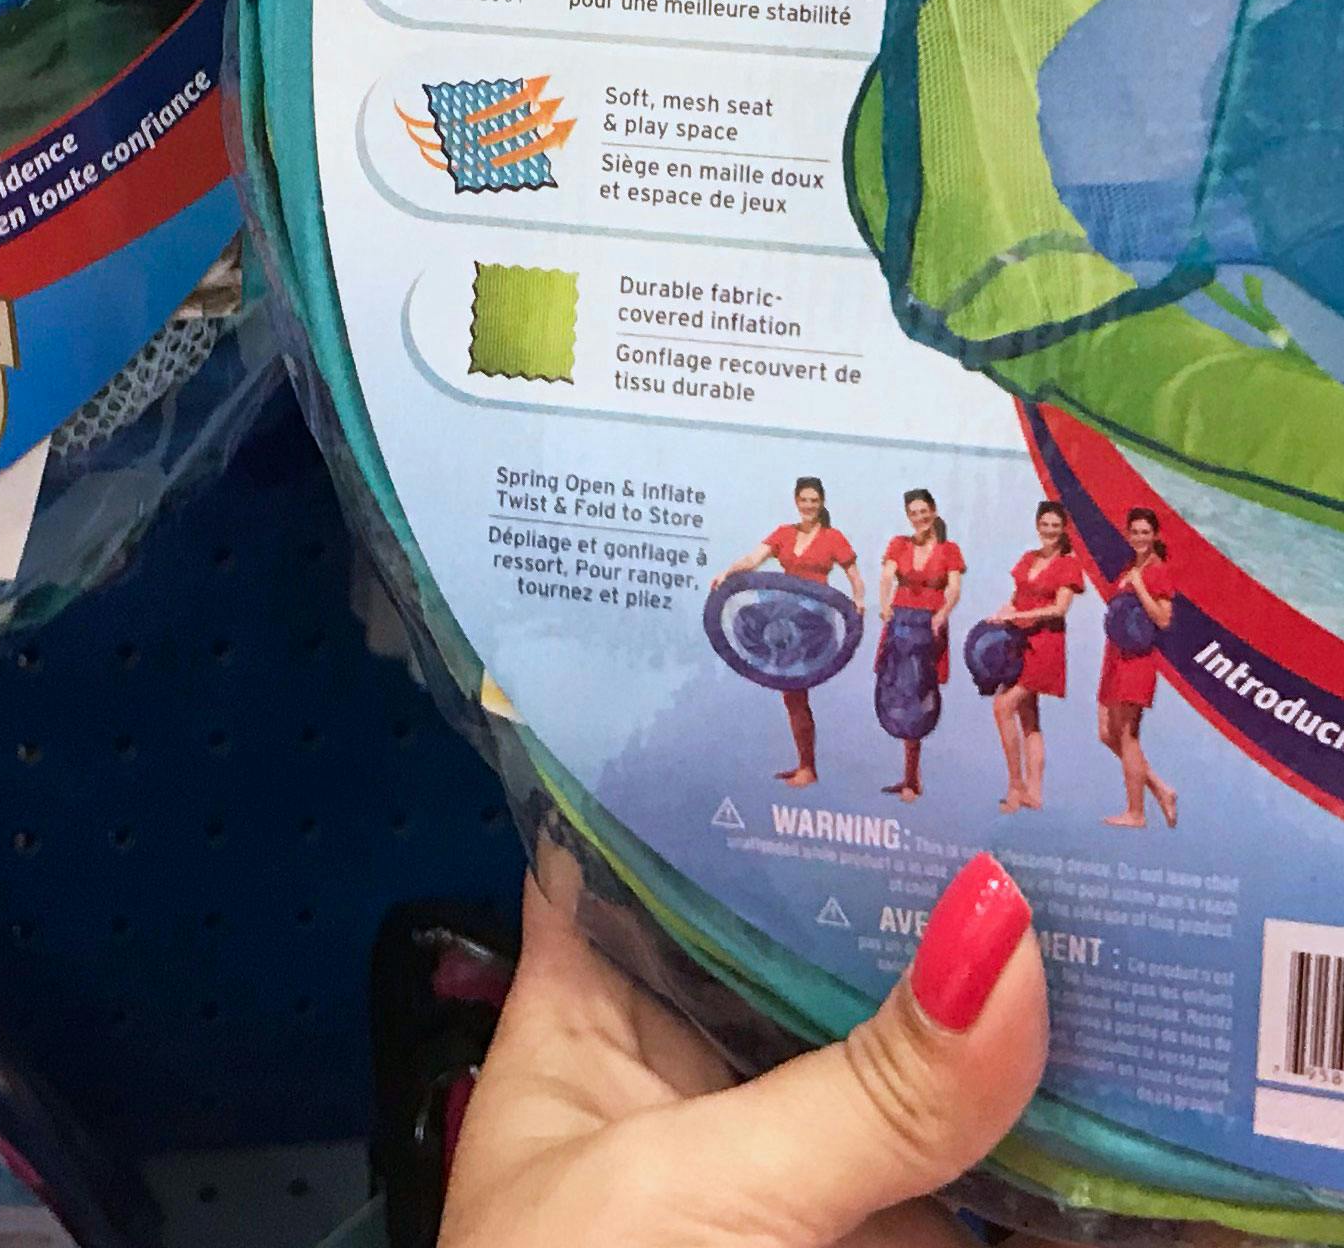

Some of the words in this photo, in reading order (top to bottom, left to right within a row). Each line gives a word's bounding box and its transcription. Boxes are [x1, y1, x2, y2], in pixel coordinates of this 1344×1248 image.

[766, 2, 851, 26] stabilité
[605, 87, 654, 111] Soft,
[663, 91, 720, 113] mesh
[725, 96, 773, 119] seat
[29, 164, 100, 217] toute
[101, 69, 212, 174] confiance
[603, 114, 617, 132] &
[625, 115, 671, 141] play
[676, 120, 739, 144] space
[601, 155, 660, 181] Siège
[666, 162, 692, 181] en
[699, 162, 764, 186] maille
[771, 167, 823, 189] doux
[600, 182, 620, 200] et
[627, 186, 703, 211] espace
[710, 190, 735, 209] de
[740, 191, 787, 215] jeux
[619, 276, 703, 303] Durable
[710, 282, 783, 308] fabric-
[618, 303, 703, 330] covered
[709, 309, 802, 337] inflation
[616, 343, 712, 373] Gonflage
[719, 354, 827, 380] recouvert
[834, 364, 862, 384] de
[614, 371, 665, 395] tissu
[671, 375, 756, 403] durable
